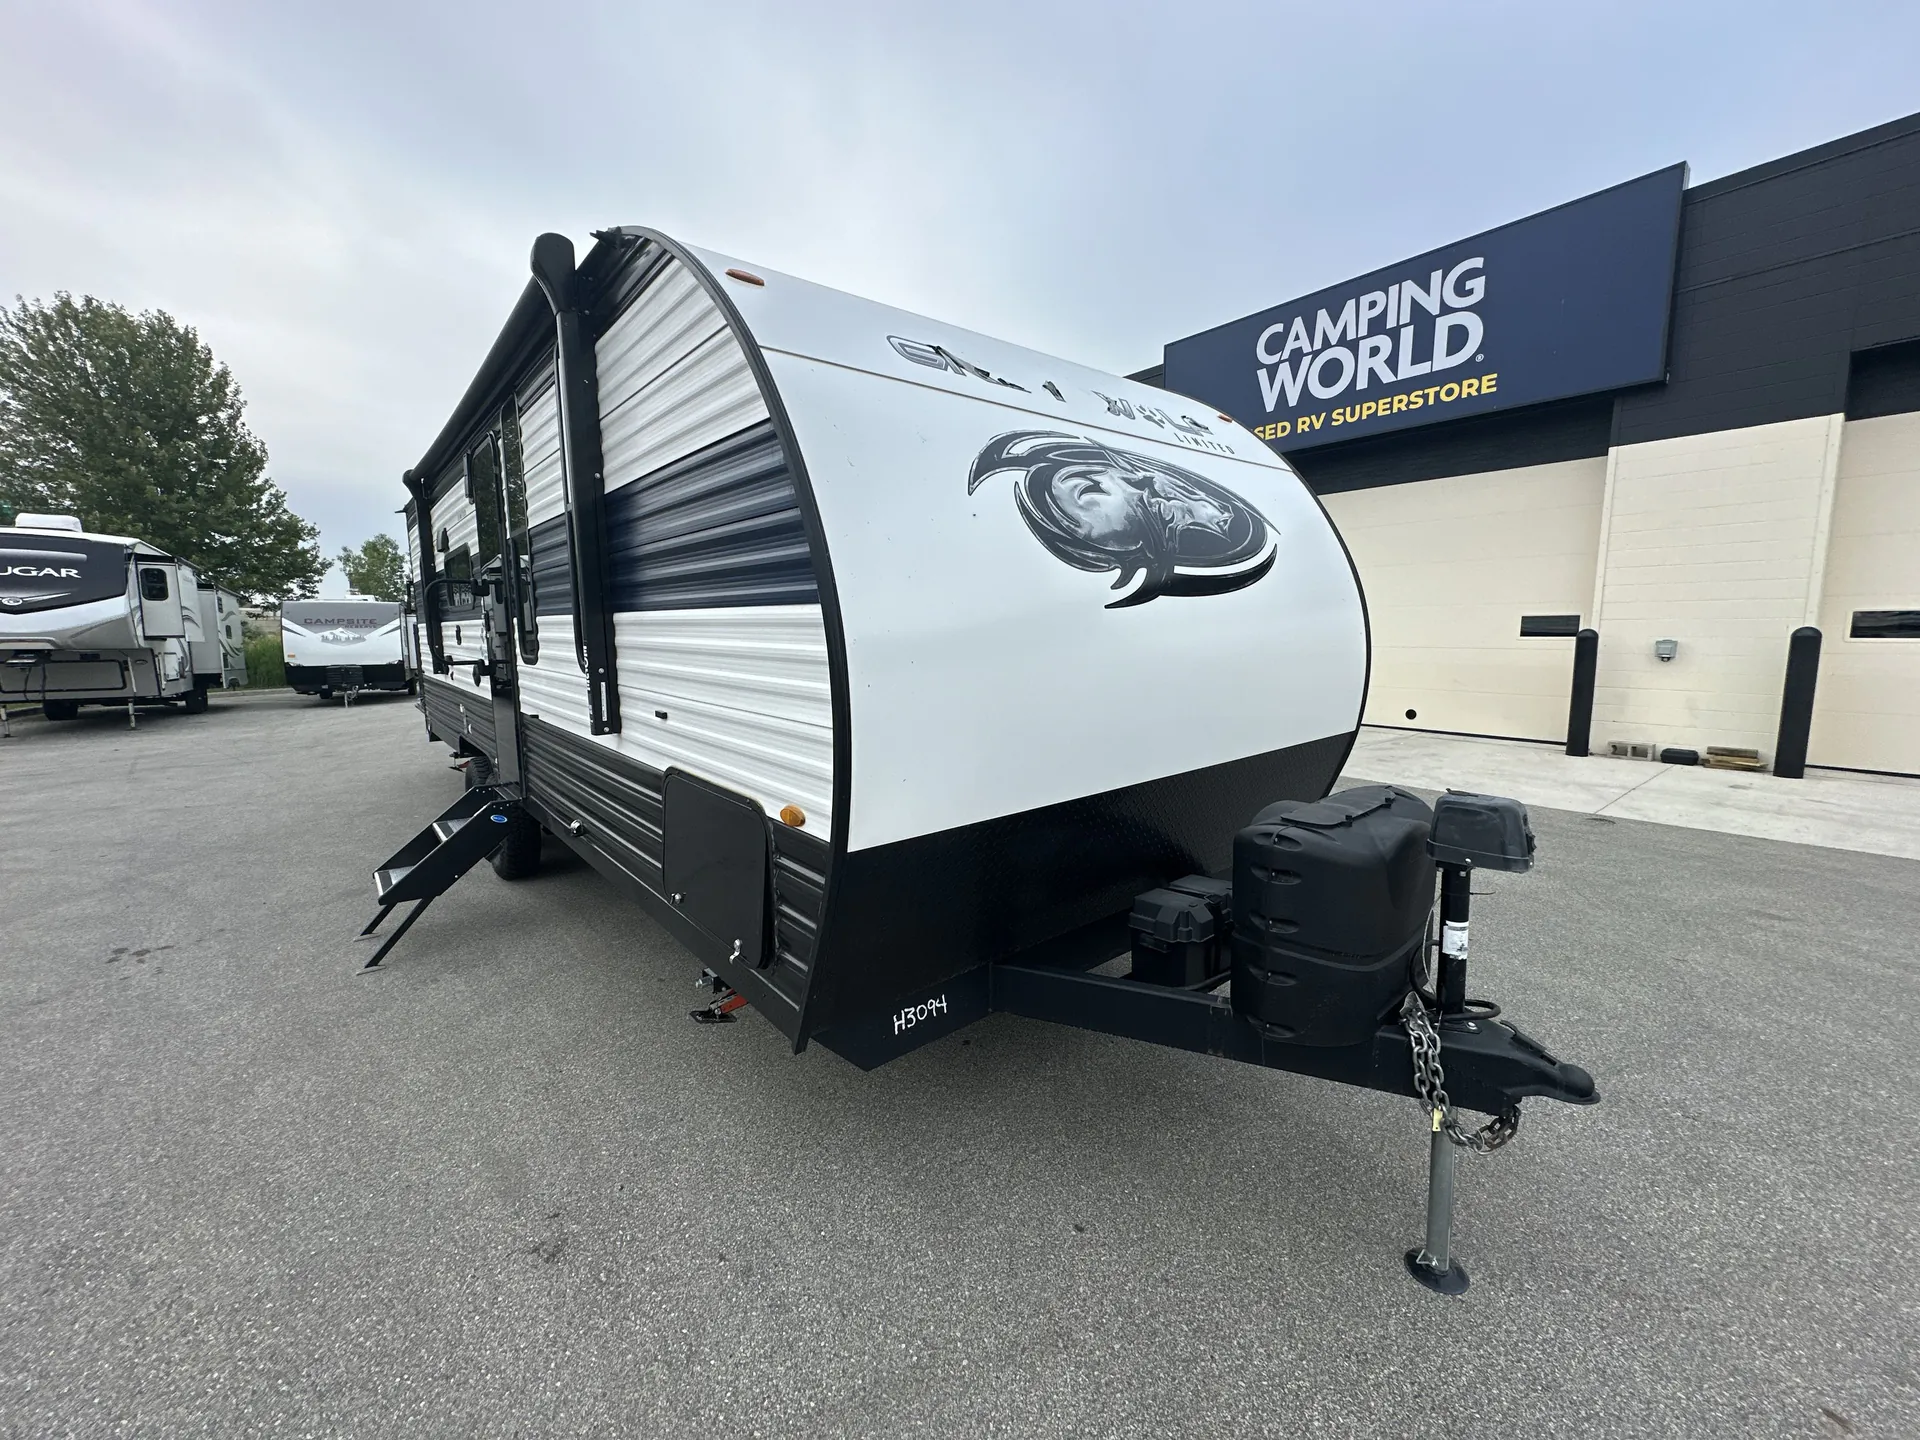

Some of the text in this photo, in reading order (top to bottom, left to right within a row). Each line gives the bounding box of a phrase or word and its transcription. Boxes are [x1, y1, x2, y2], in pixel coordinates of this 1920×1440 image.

[1256, 256, 1486, 365] CAMPING
[1256, 310, 1485, 413] WORLD
[1253, 373, 1499, 441] SED RV SUPERSTORE
[1173, 432, 1236, 455] LIMITED
[893, 993, 948, 1035] H3094
